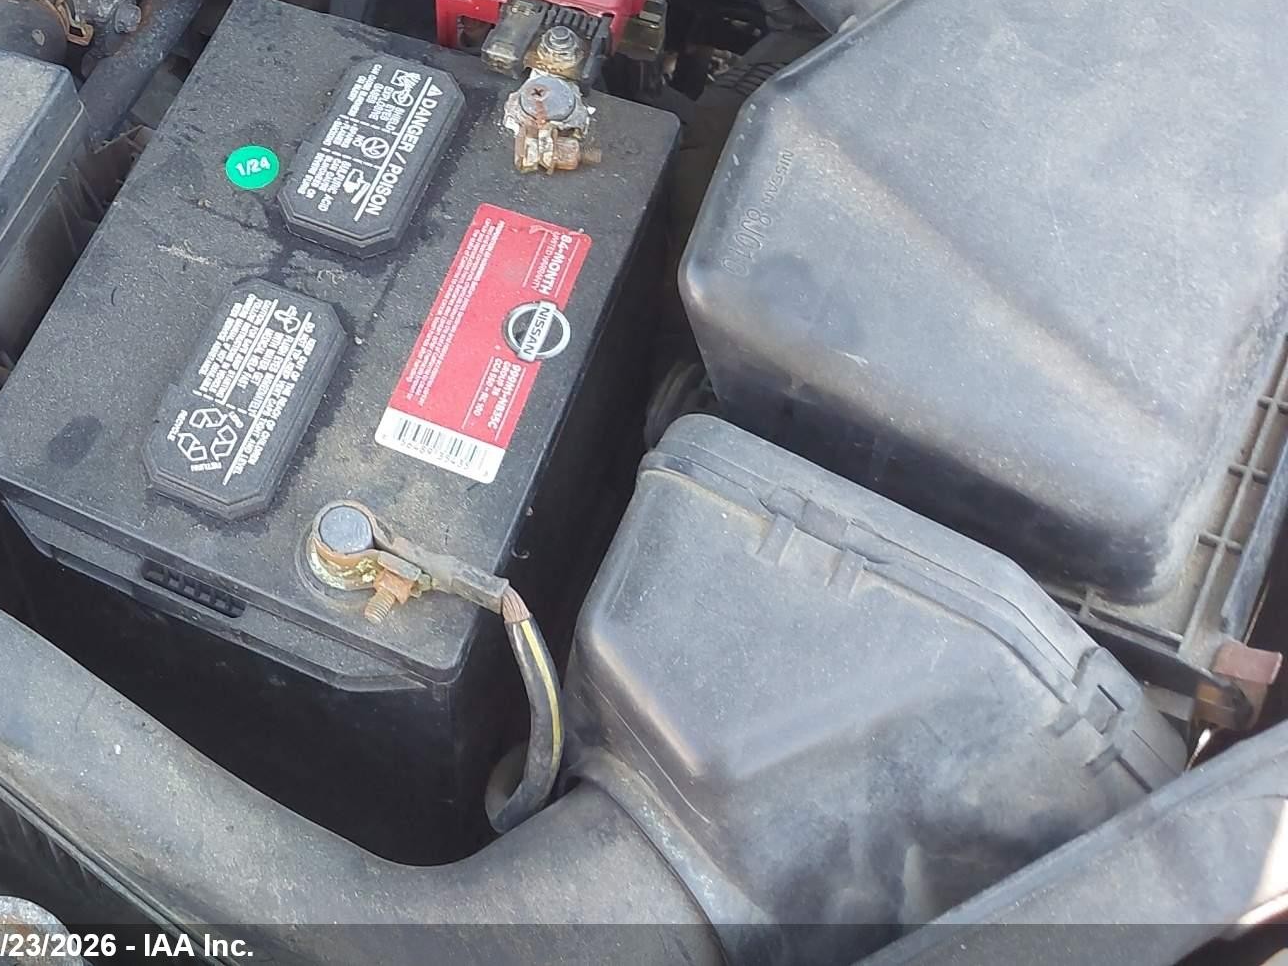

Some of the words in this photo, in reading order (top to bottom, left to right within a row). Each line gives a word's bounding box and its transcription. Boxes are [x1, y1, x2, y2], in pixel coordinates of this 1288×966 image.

[384, 106, 405, 131] SHIELD
[396, 96, 438, 153] DANGER
[350, 133, 365, 147] NO
[235, 156, 270, 176] 1/24
[390, 151, 410, 165] /
[363, 162, 404, 216] POISON
[316, 193, 335, 212] ACID
[536, 233, 573, 296] 84-MONTH
[303, 321, 316, 334] DO
[520, 306, 551, 356] NISSAN
[293, 354, 308, 371] OUT
[288, 369, 301, 382] OF
[494, 360, 512, 387] GROUP
[271, 378, 287, 398] VENT
[280, 380, 295, 397] THE
[263, 418, 276, 431] OF
[243, 437, 257, 455] AND
[232, 453, 249, 476] LEVEL
